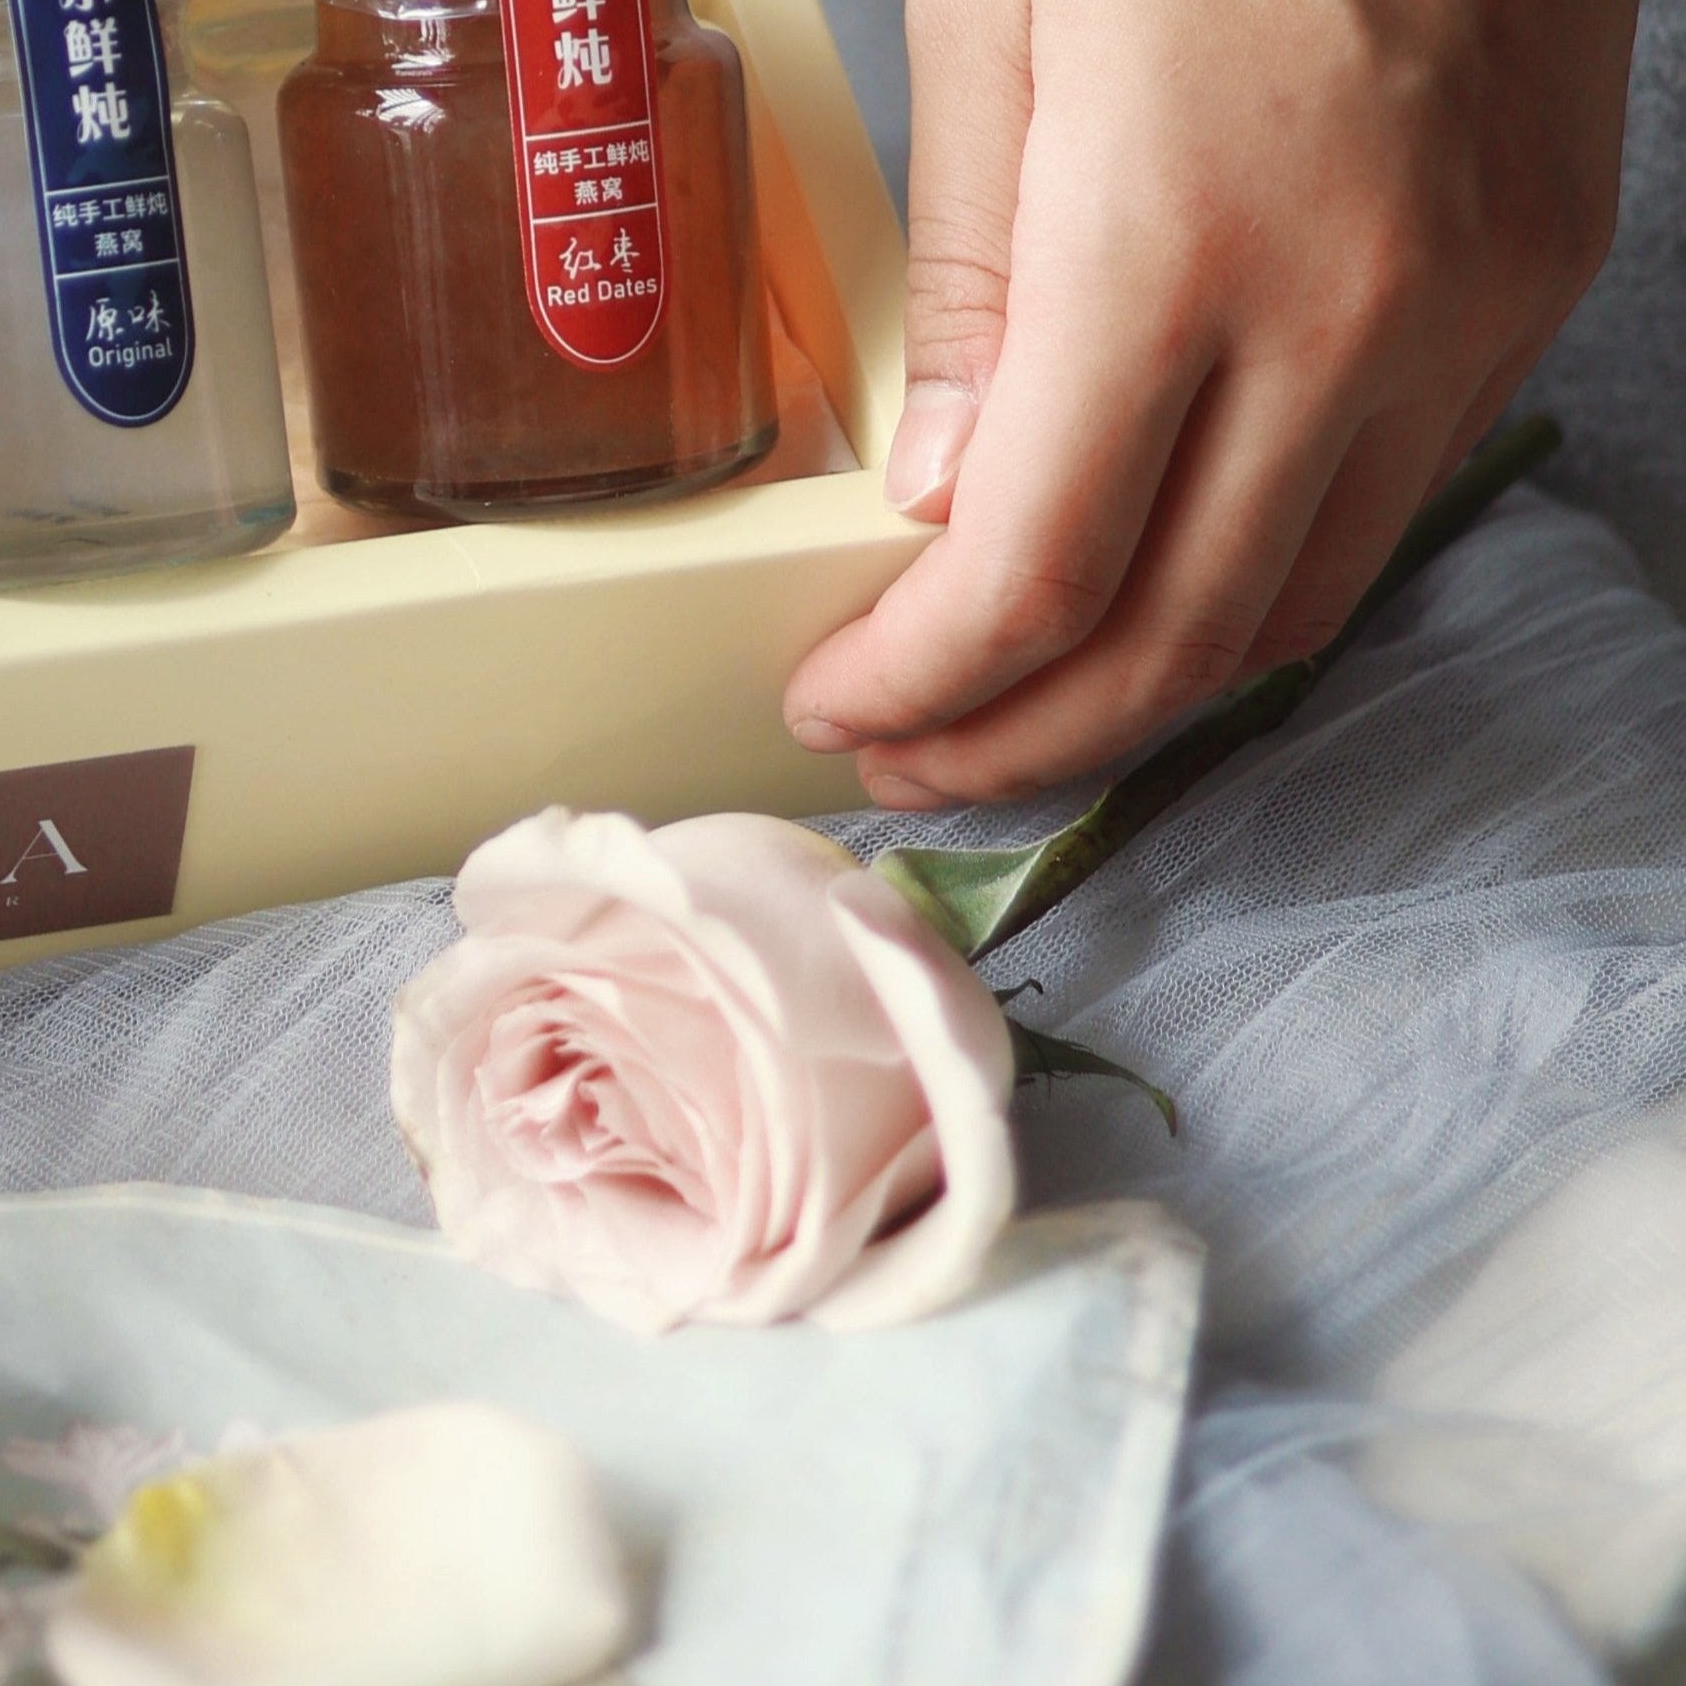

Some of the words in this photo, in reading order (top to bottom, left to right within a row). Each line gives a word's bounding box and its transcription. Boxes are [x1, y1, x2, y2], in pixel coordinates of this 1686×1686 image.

[533, 138, 650, 176] 纯手工鲜炖
[574, 177, 623, 206] 燕窝
[53, 191, 168, 227] 纯手工鲜炖
[94, 229, 143, 256] 燕窝
[547, 282, 589, 306] Red
[599, 277, 657, 300] Dates
[85, 290, 171, 342] 原味
[88, 337, 173, 369] Original
